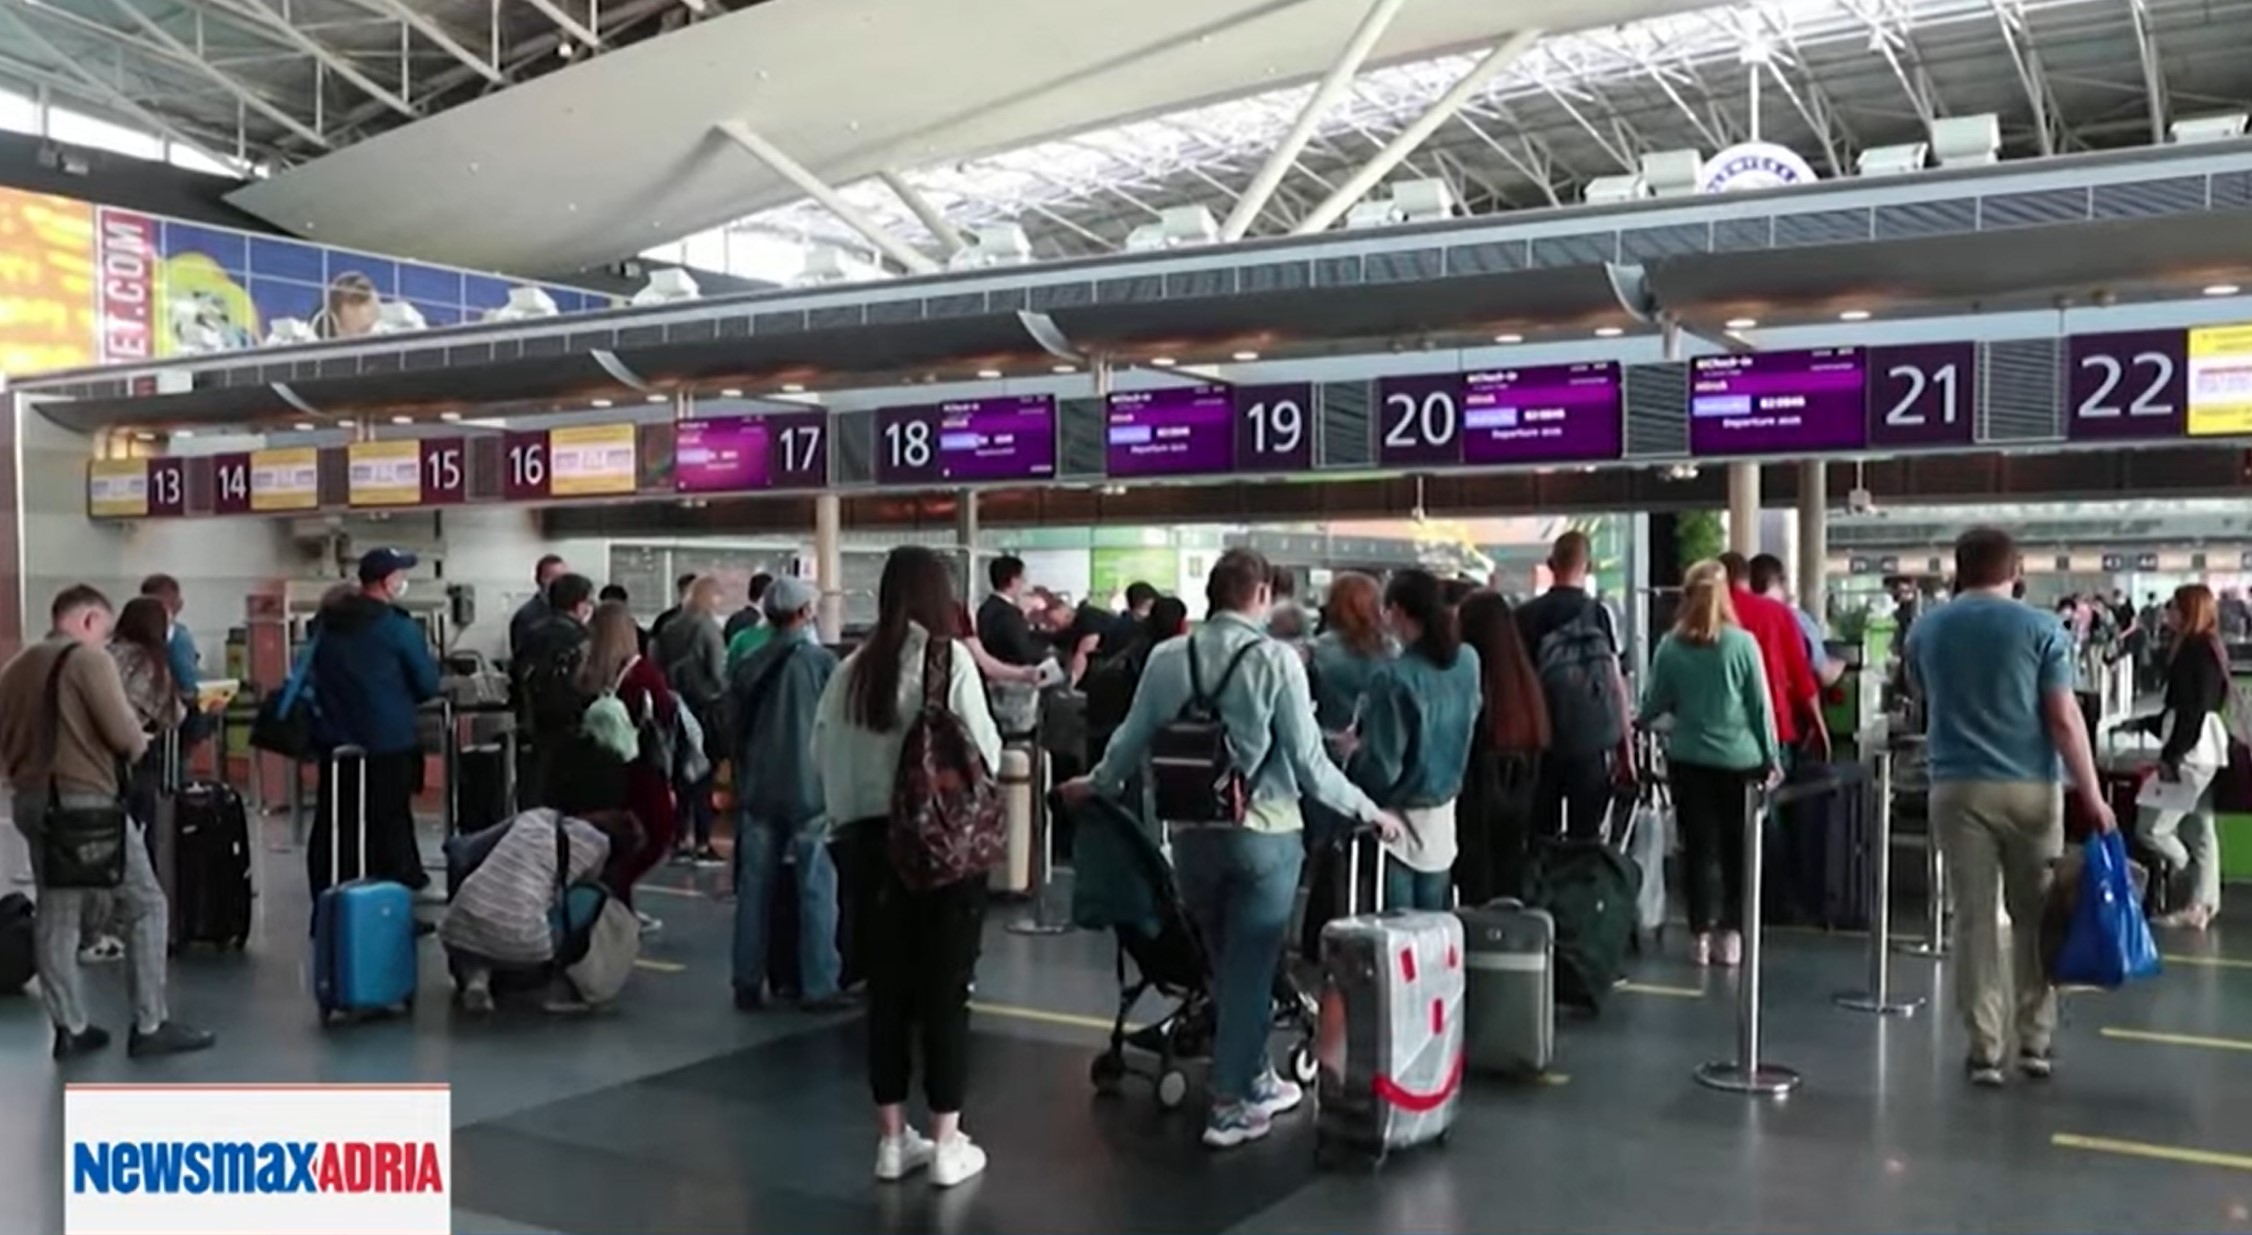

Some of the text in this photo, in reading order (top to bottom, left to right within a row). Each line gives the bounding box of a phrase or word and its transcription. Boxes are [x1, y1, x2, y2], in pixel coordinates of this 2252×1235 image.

[1886, 364, 1956, 425] 21
[2078, 351, 2173, 418] 22
[1247, 400, 1302, 453] 19
[1385, 391, 1455, 446] 20
[510, 444, 544, 486] 16
[780, 426, 820, 471] 17
[885, 420, 930, 467] 18
[154, 468, 181, 504] 13
[219, 465, 247, 500] 14
[428, 450, 461, 489] 15
